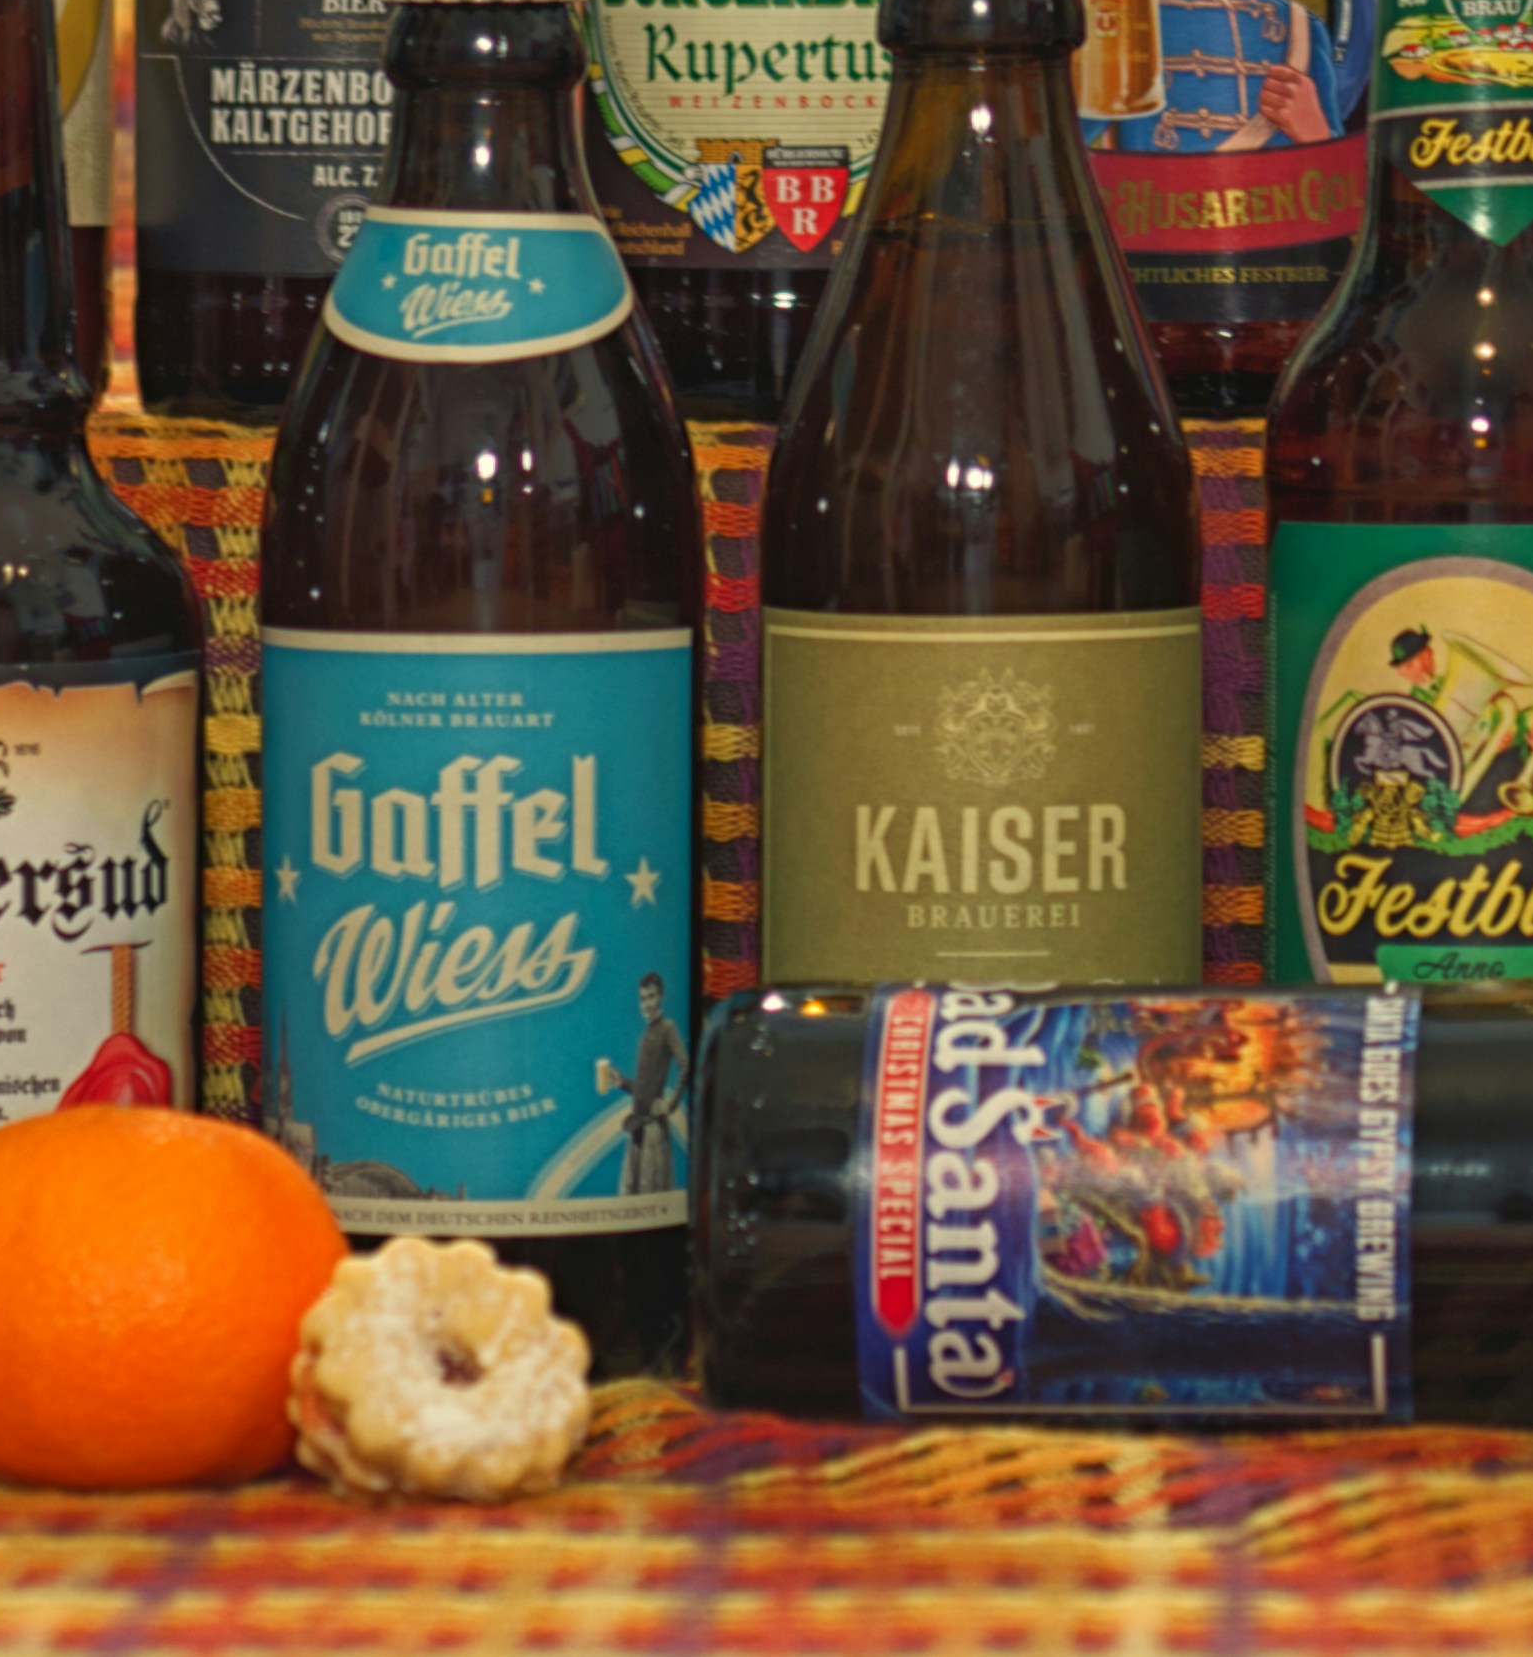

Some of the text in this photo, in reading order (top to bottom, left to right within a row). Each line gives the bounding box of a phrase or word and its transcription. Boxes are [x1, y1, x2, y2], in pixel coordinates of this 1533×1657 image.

[211, 62, 395, 106] MÄRZENBO
[667, 94, 879, 111] WEIZENBOCK
[313, 164, 358, 188] ALC.
[403, 232, 521, 280] Gaffel
[399, 281, 514, 334] Wiess
[386, 691, 525, 708] NACH ALTER
[360, 709, 554, 729] KÖLNER BRAUART
[311, 752, 608, 892] Gaffel
[855, 803, 1128, 895] KAISER
[907, 903, 1081, 929] BRAUEREI
[313, 900, 596, 1044] Wiess
[1412, 951, 1507, 982] Anno
[376, 1081, 533, 1108] NATURTRÜBES
[506, 1097, 558, 1123] BIER
[878, 1158, 916, 1281] SPECIAL
